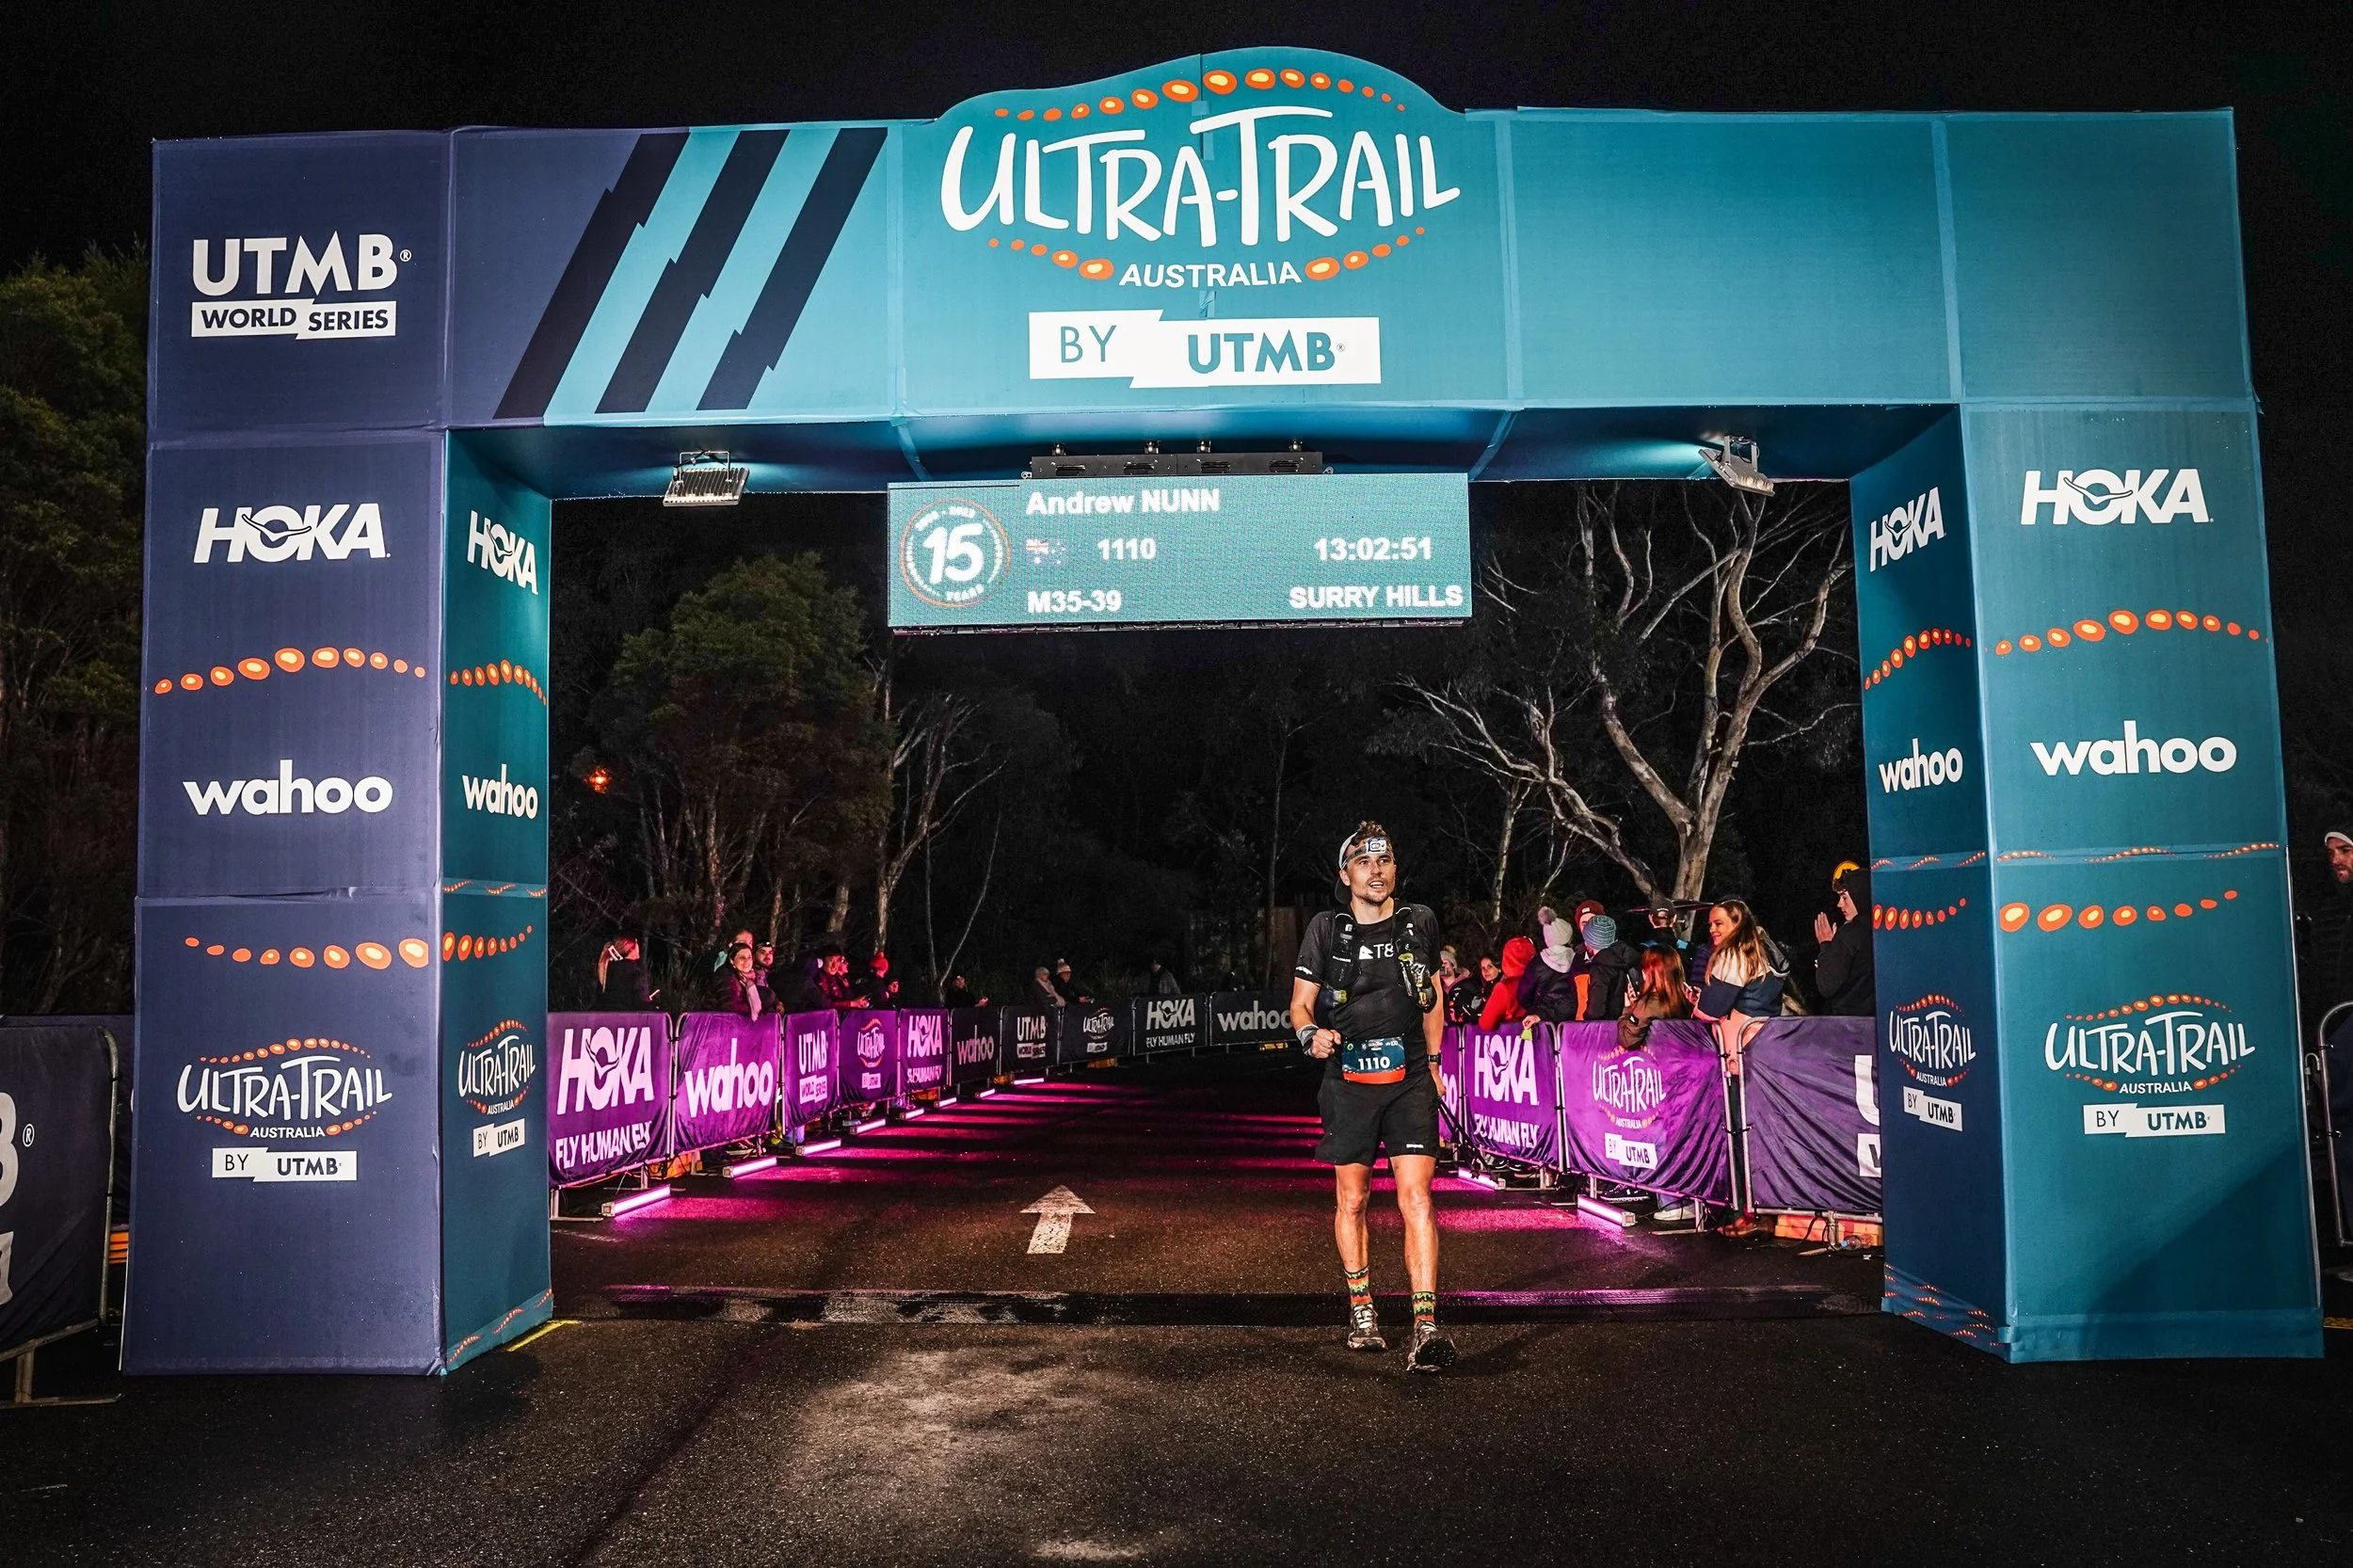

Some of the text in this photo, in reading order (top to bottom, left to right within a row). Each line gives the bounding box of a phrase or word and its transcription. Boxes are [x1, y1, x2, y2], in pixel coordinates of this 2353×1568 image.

[940, 105, 1462, 248] ULTRA-TRAIL
[1118, 261, 1303, 288] AUSTRALIA
[200, 307, 389, 333] WORLD SERIES
[1060, 325, 1118, 363] BY
[1026, 488, 1220, 515] Andrew NUNN
[2020, 469, 2214, 525] HOKA
[193, 503, 387, 564] HOKA
[1869, 486, 1945, 572] HOKA
[467, 509, 539, 595] HOKA
[922, 522, 984, 584] 15
[1096, 537, 1157, 561] 1110
[1314, 536, 1432, 561] 13:02:51
[1027, 588, 1122, 614] M35-39
[1289, 584, 1464, 610] SURRY HILLS
[2030, 720, 2237, 776] wahoo
[1879, 738, 1963, 792] wahoo
[183, 759, 393, 815] wahoo
[461, 763, 538, 819] wahoo
[1016, 1015, 1047, 1042] UTMB
[1145, 998, 1196, 1030] HOKA
[1217, 1000, 1292, 1032] wahoo
[798, 1029, 827, 1075] UTMB
[907, 1015, 943, 1058] HOKA
[956, 1025, 994, 1065] wahoo
[1158, 1034, 1184, 1046] HUMAN
[1184, 1032, 1195, 1044] FLY
[1888, 1010, 1977, 1070] ULTRA-TRAIL
[2044, 1012, 2255, 1075] ULTRA-TRAIL
[457, 1035, 536, 1097] ULTRA-TRAIL
[556, 1027, 655, 1115] HOKA
[684, 1037, 774, 1117] wahoo
[1357, 1056, 1391, 1071] 1110
[1474, 1034, 1540, 1106] HOKA
[1915, 1071, 1947, 1087] AUSTRALIA
[178, 1055, 392, 1119] ULTRA-TRAIL
[801, 1079, 826, 1099] WORLD SERIES
[1593, 1056, 1666, 1112] ULTRA-TRAIL
[2119, 1080, 2193, 1095] AUSTRALIA
[487, 1099, 515, 1115] AUSTRALIA
[1615, 1116, 1641, 1128] AUSTRALIA
[1907, 1093, 1955, 1124] BY UTMB
[2095, 1110, 2120, 1128] BY
[249, 1127, 326, 1138] AUSTRALIA
[478, 1126, 520, 1149] BY UTMB
[555, 1135, 579, 1171] FLY
[581, 1125, 633, 1164] HUMAN
[1520, 1121, 1540, 1148] FLY
[224, 1153, 249, 1172] BY
[1625, 1145, 1650, 1163] UTMB
